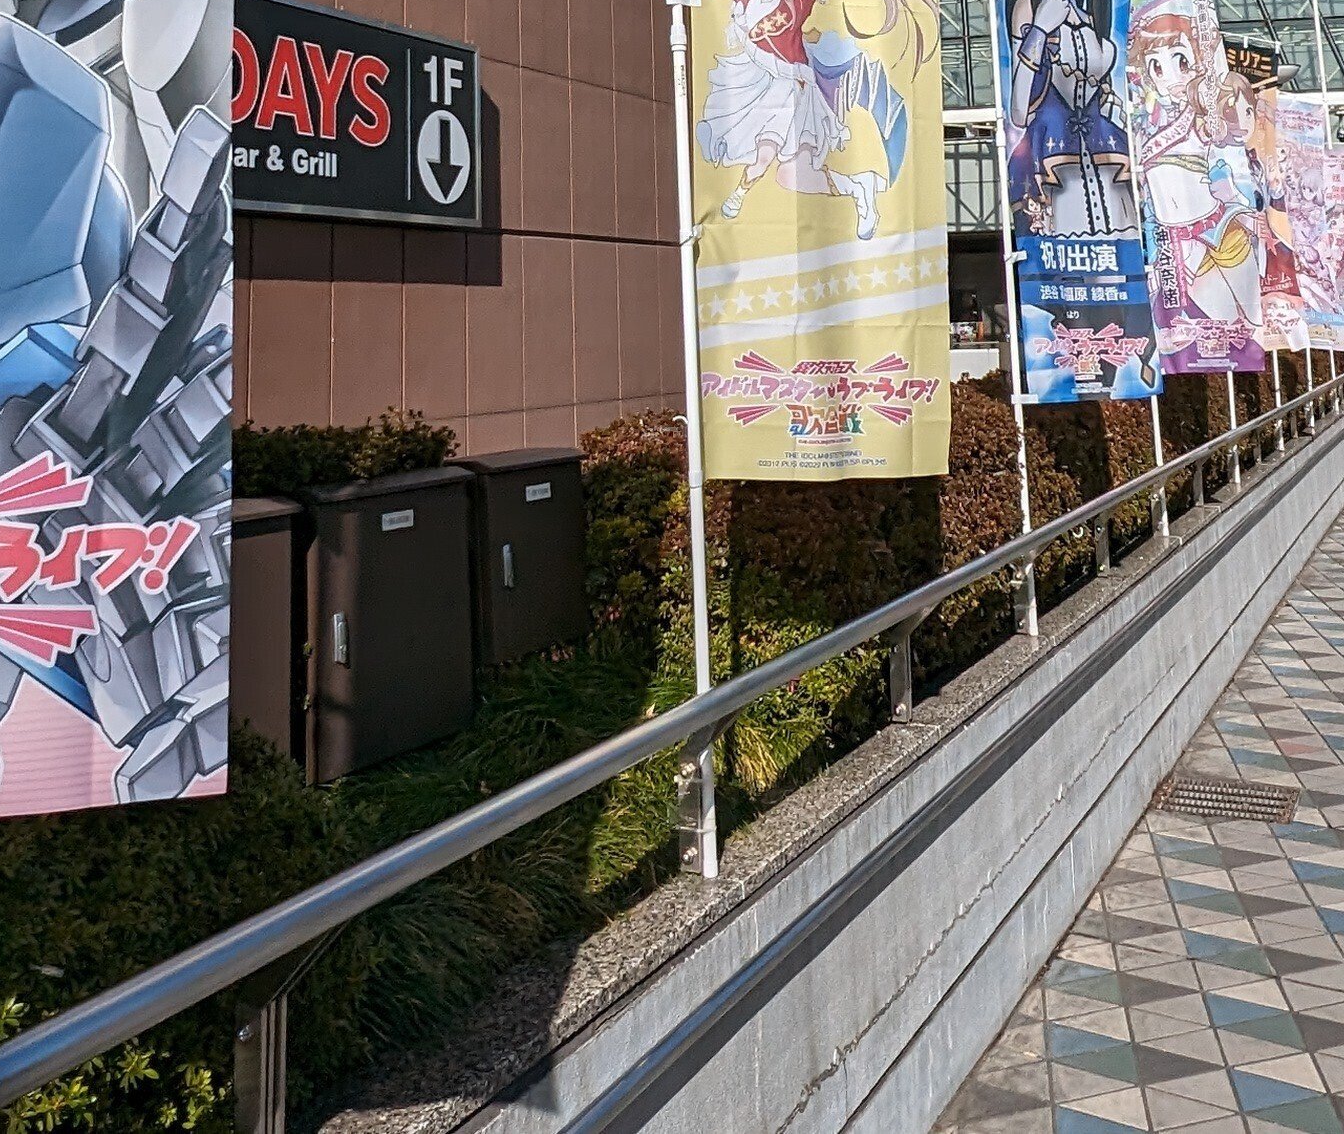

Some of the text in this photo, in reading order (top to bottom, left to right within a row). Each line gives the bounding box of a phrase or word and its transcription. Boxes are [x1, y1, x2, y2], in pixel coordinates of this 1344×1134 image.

[1227, 48, 1272, 70] ミリアニ
[424, 55, 464, 106] 1F
[266, 145, 284, 171] &
[292, 148, 338, 178] Grill
[836, 375, 940, 403] ラブライブ!
